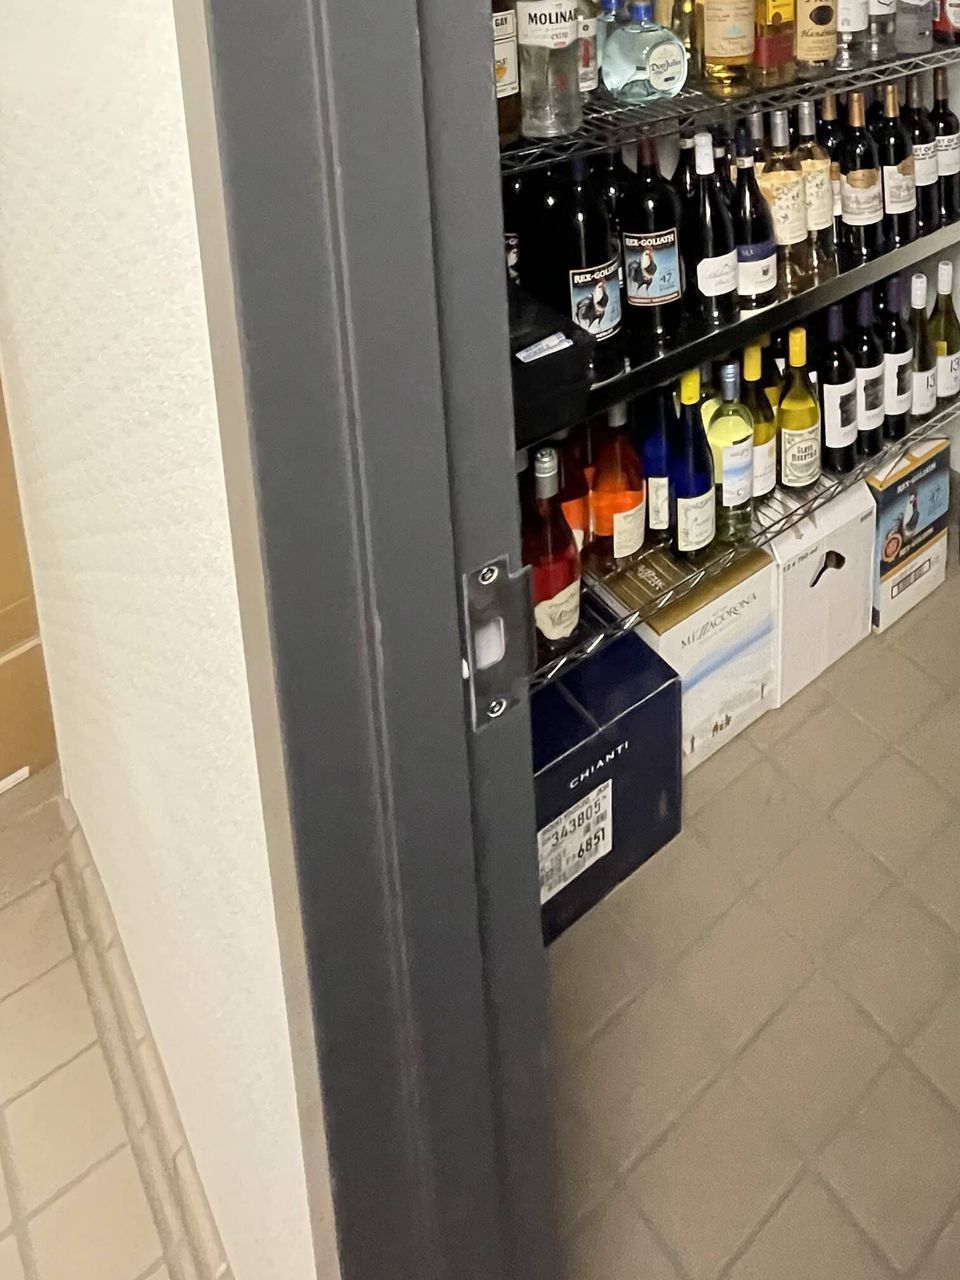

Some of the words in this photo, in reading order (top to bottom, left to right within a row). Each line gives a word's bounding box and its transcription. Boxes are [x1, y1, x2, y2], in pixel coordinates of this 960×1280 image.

[494, 16, 508, 28] GAY
[625, 233, 674, 247] REX-GOLIATH
[950, 357, 960, 373] 13
[680, 592, 758, 650] MEZZACORONA
[569, 740, 629, 789] CHIANTI
[551, 798, 602, 848] 343805
[577, 827, 606, 859] 6851
